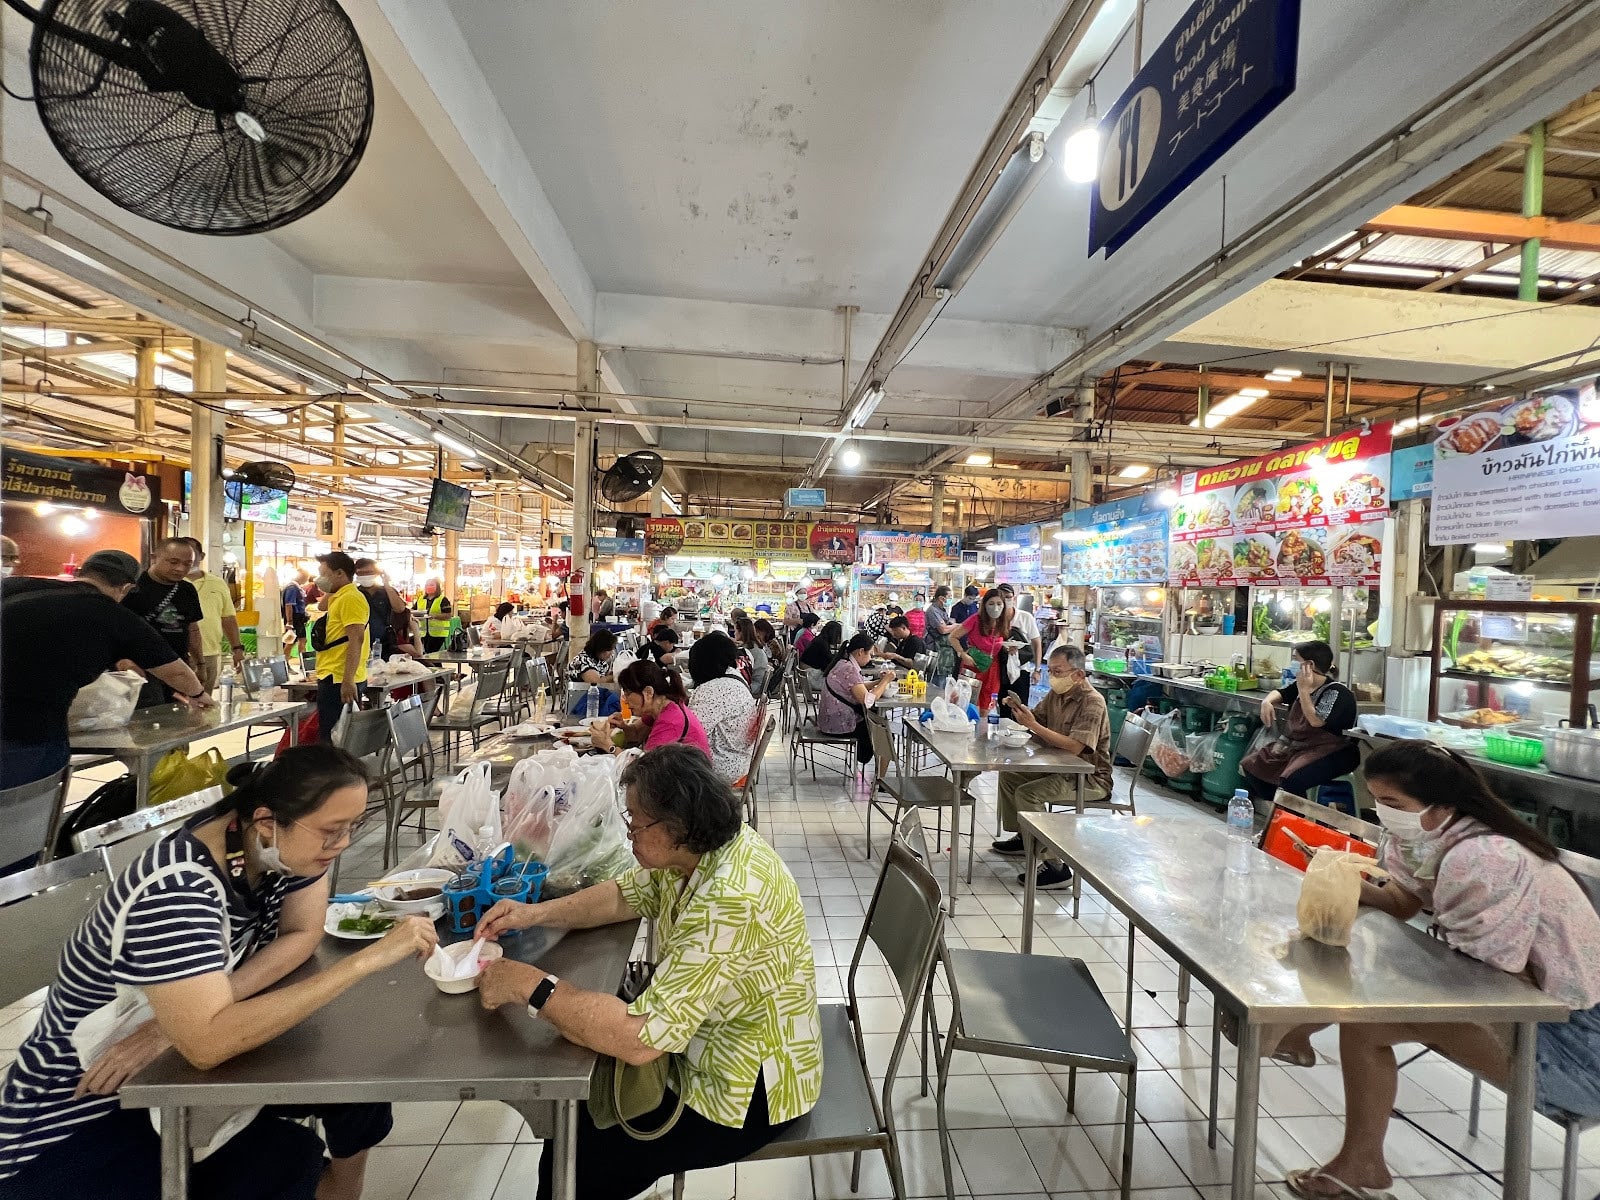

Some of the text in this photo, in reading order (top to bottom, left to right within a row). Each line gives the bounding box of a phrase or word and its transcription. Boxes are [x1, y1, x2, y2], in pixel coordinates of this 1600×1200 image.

[1172, 39, 1206, 91] Food
[1169, 63, 1254, 157] フードコート
[1529, 480, 1560, 489] chicken
